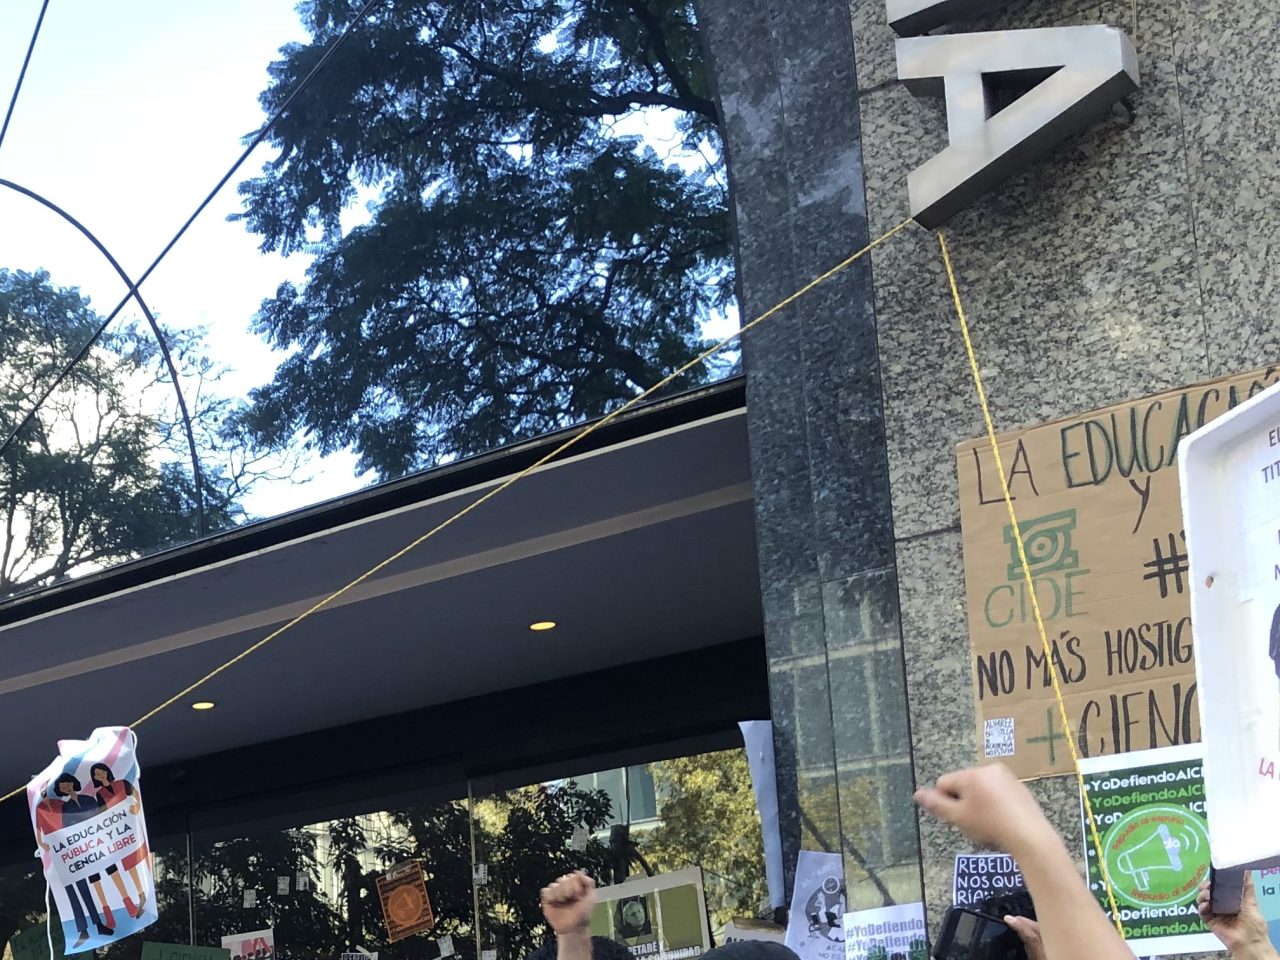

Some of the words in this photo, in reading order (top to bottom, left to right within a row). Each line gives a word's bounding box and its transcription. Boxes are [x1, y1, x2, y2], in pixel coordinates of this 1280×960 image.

[973, 438, 1039, 505] LA
[1129, 476, 1151, 534] Y
[984, 568, 1090, 628] CIDE
[977, 650, 1015, 700] NO
[1026, 630, 1087, 690] MÁS
[53, 841, 66, 854] LA
[66, 808, 128, 847] EDUCACIÓN
[61, 837, 104, 864] PÚBLICA
[106, 830, 114, 841] Y
[116, 822, 132, 836] LA
[69, 850, 106, 873] CIENCIA
[108, 833, 137, 854] LIBRE
[957, 875, 990, 889] NOS
[992, 873, 1023, 888] QUE
